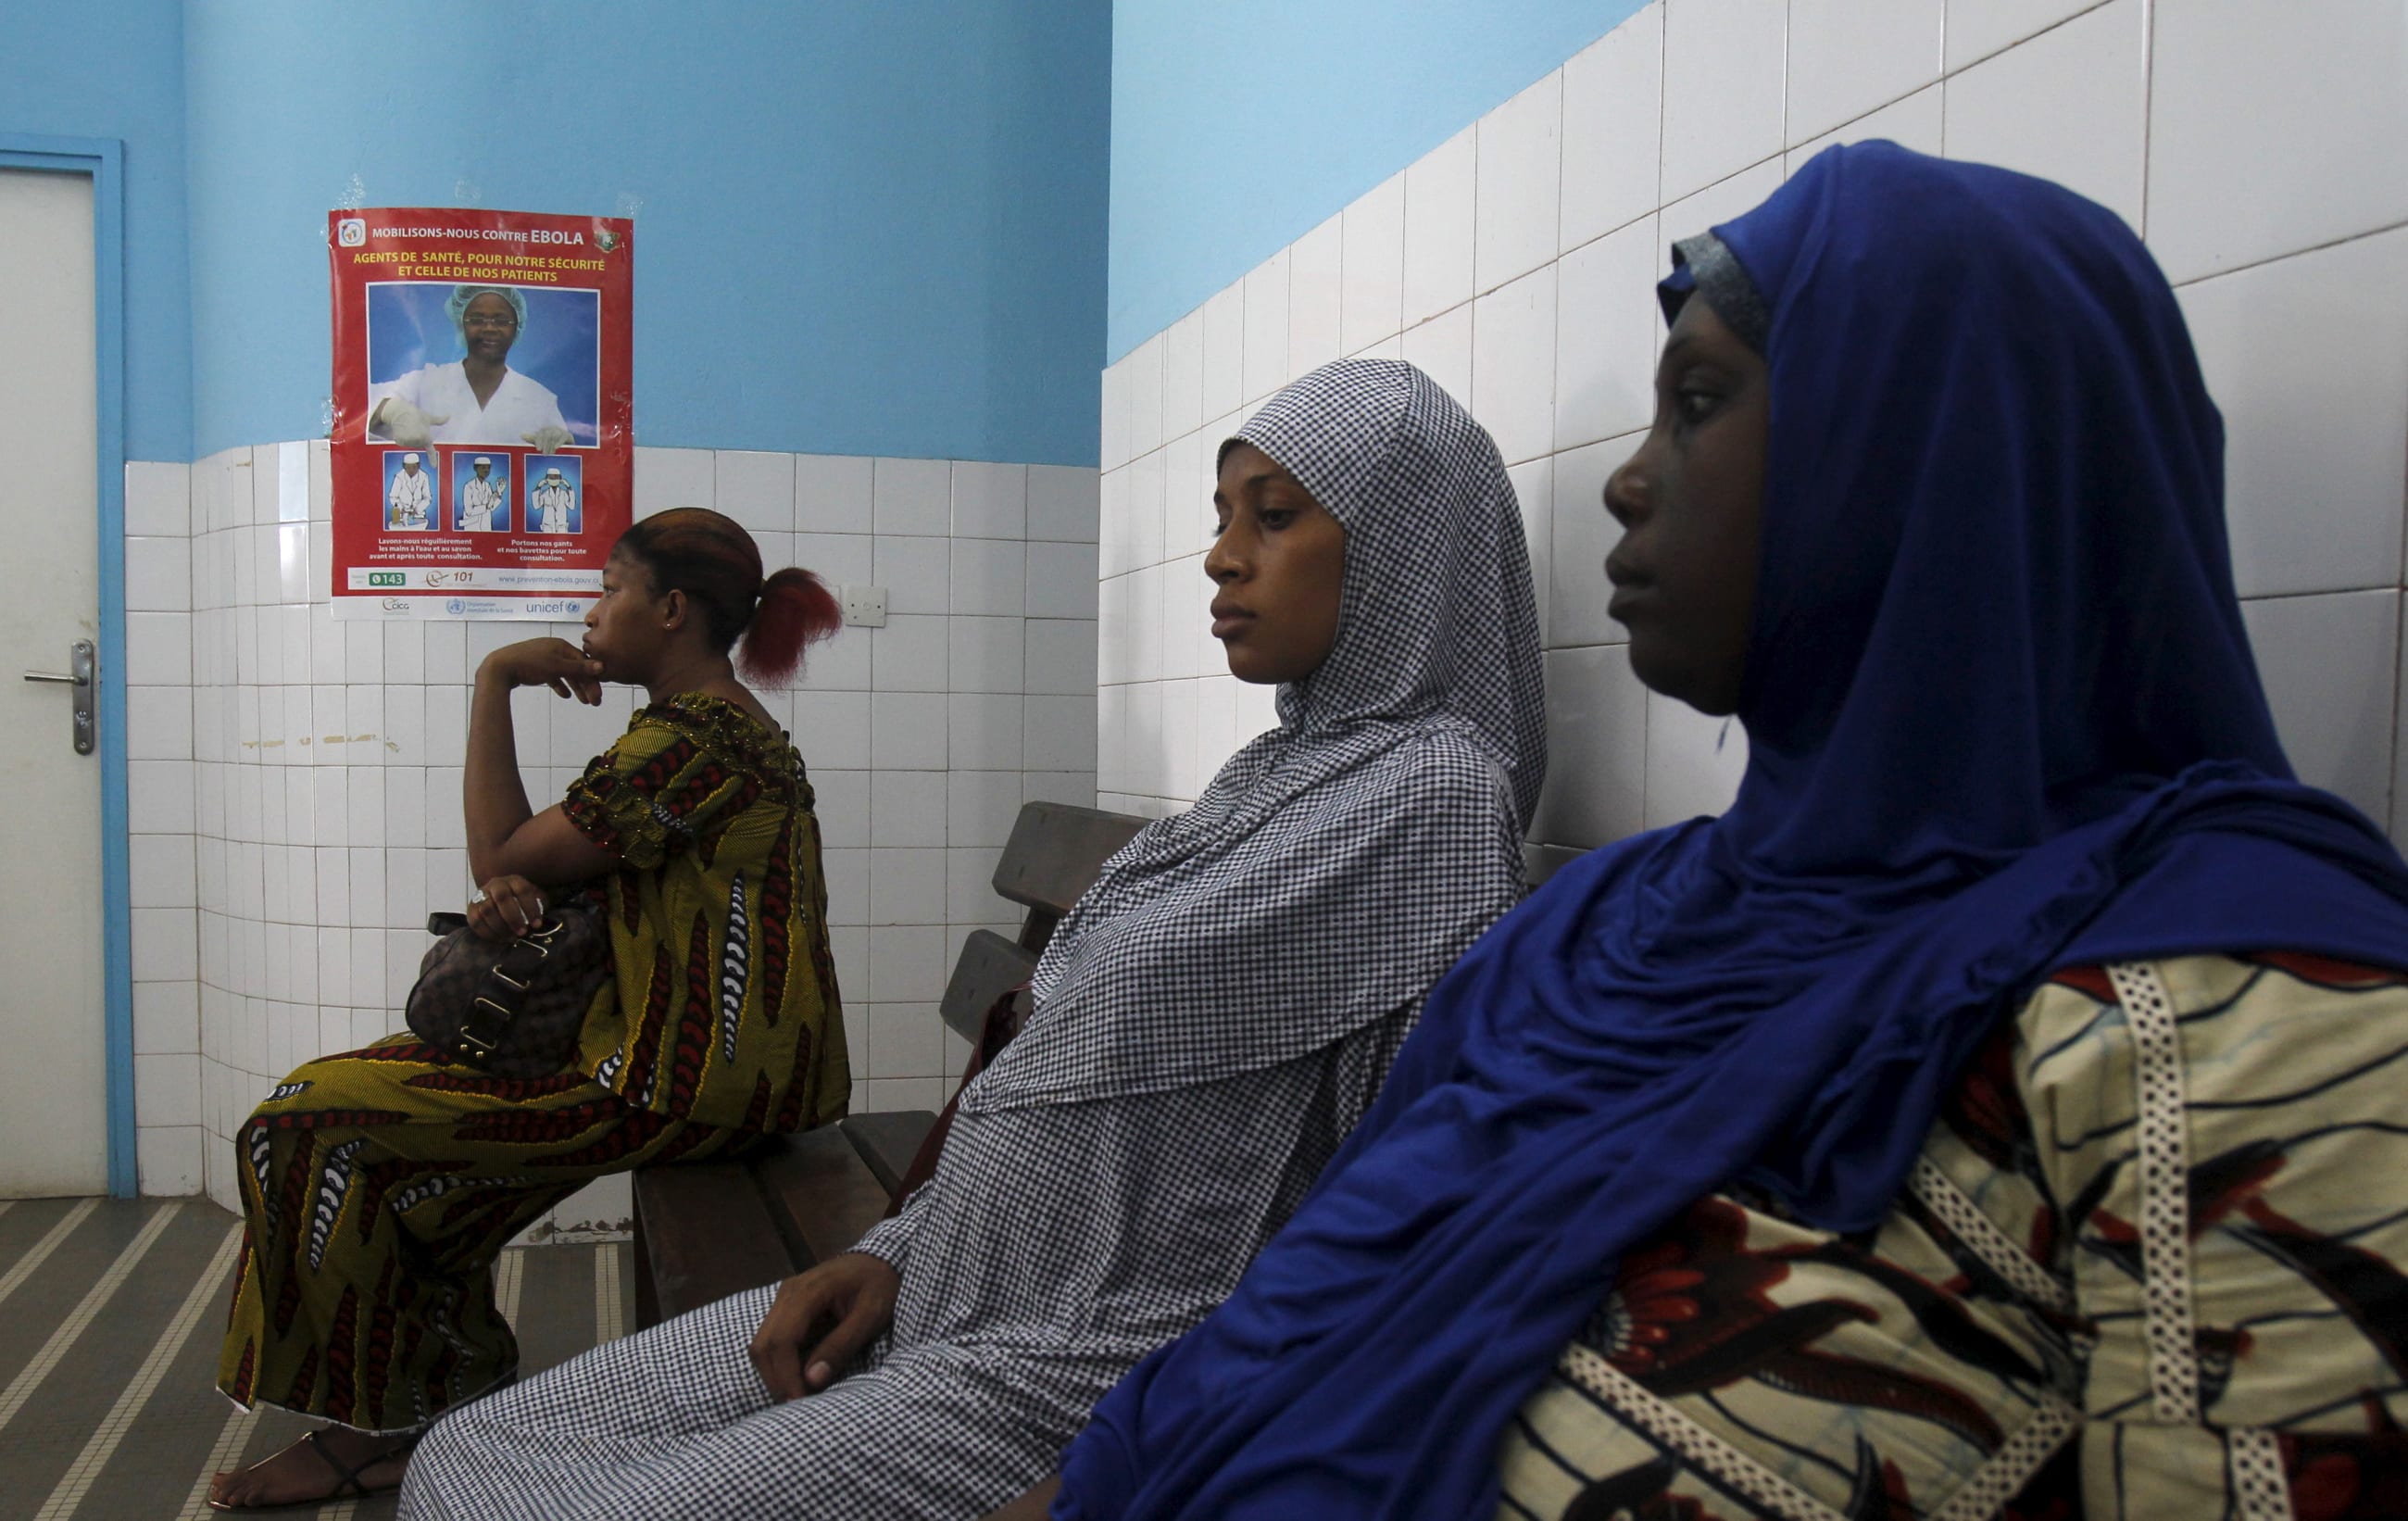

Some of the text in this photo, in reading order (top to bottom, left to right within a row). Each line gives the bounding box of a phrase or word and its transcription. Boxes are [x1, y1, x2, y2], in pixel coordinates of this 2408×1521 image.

[372, 228, 584, 245] MOBILISONS-NOUS CONTRE EBOLA
[354, 251, 605, 270] AGENTS DE SANTÉ, POUR NOTRE SÉCURITÉ
[398, 266, 558, 282] ET CELLE DE NOS PATIENTS
[383, 574, 403, 585] 143
[454, 572, 473, 582] 101
[526, 601, 563, 612] unicef
